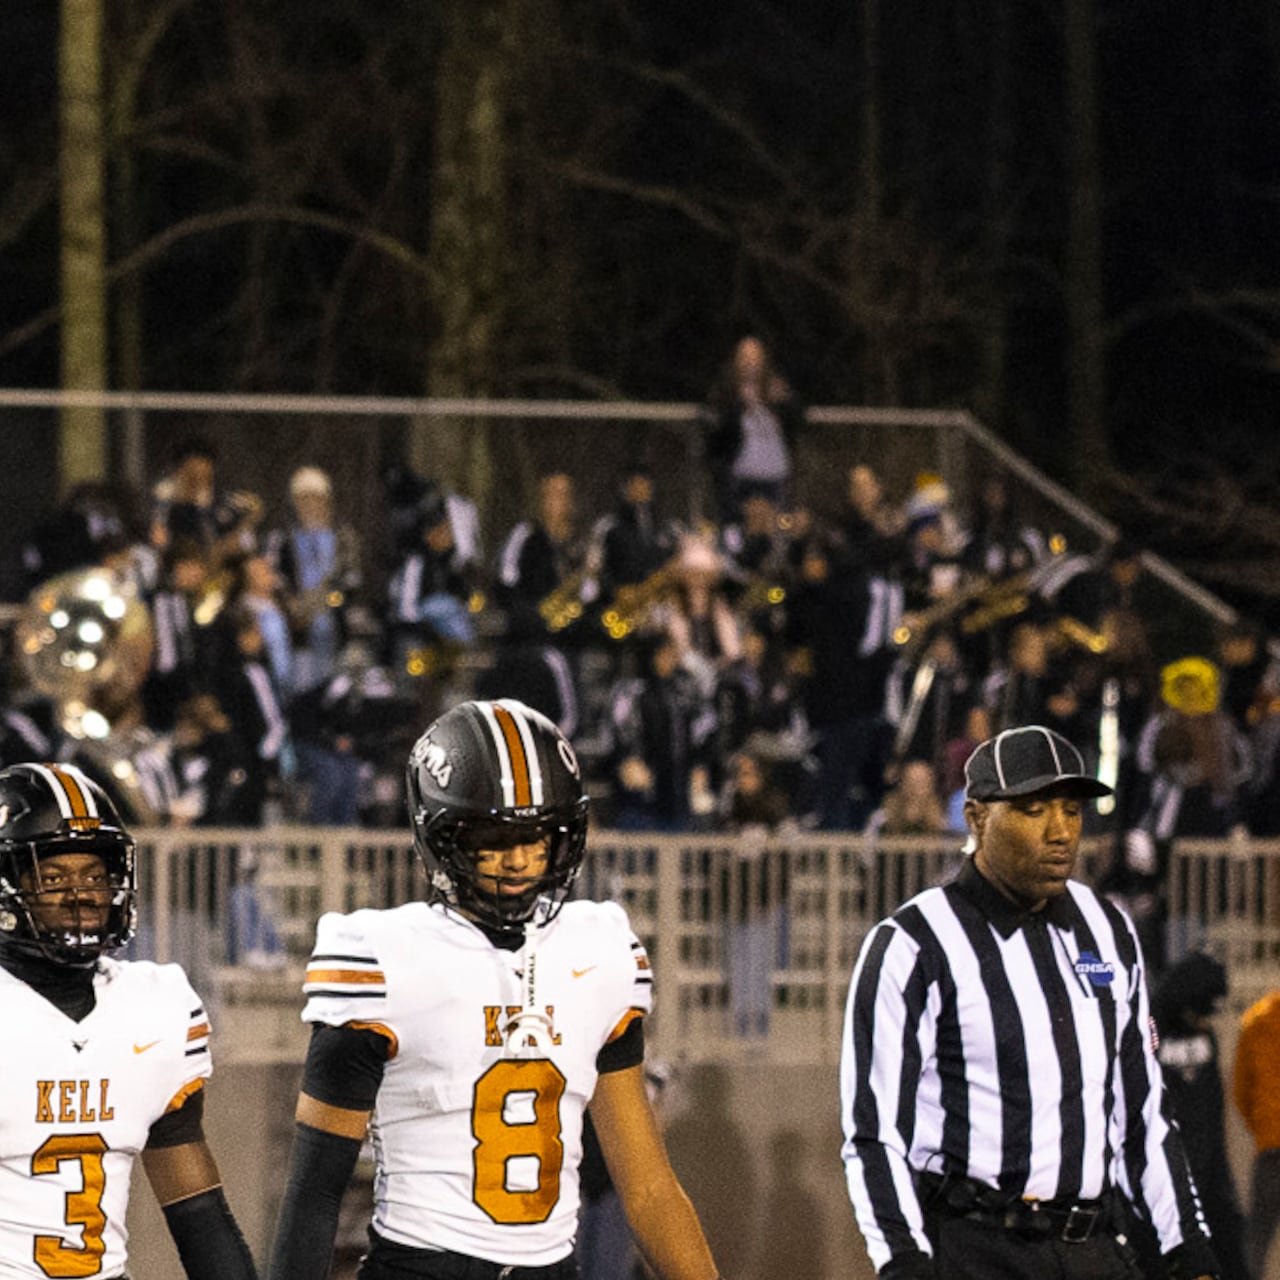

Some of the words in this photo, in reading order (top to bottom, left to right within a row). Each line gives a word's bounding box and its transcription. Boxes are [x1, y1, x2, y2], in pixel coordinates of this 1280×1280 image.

[1074, 962, 1114, 973] GHSA
[483, 1005, 562, 1047] KL
[35, 1079, 115, 1123] KELL
[470, 1058, 567, 1225] 8
[30, 1132, 111, 1279] 3
